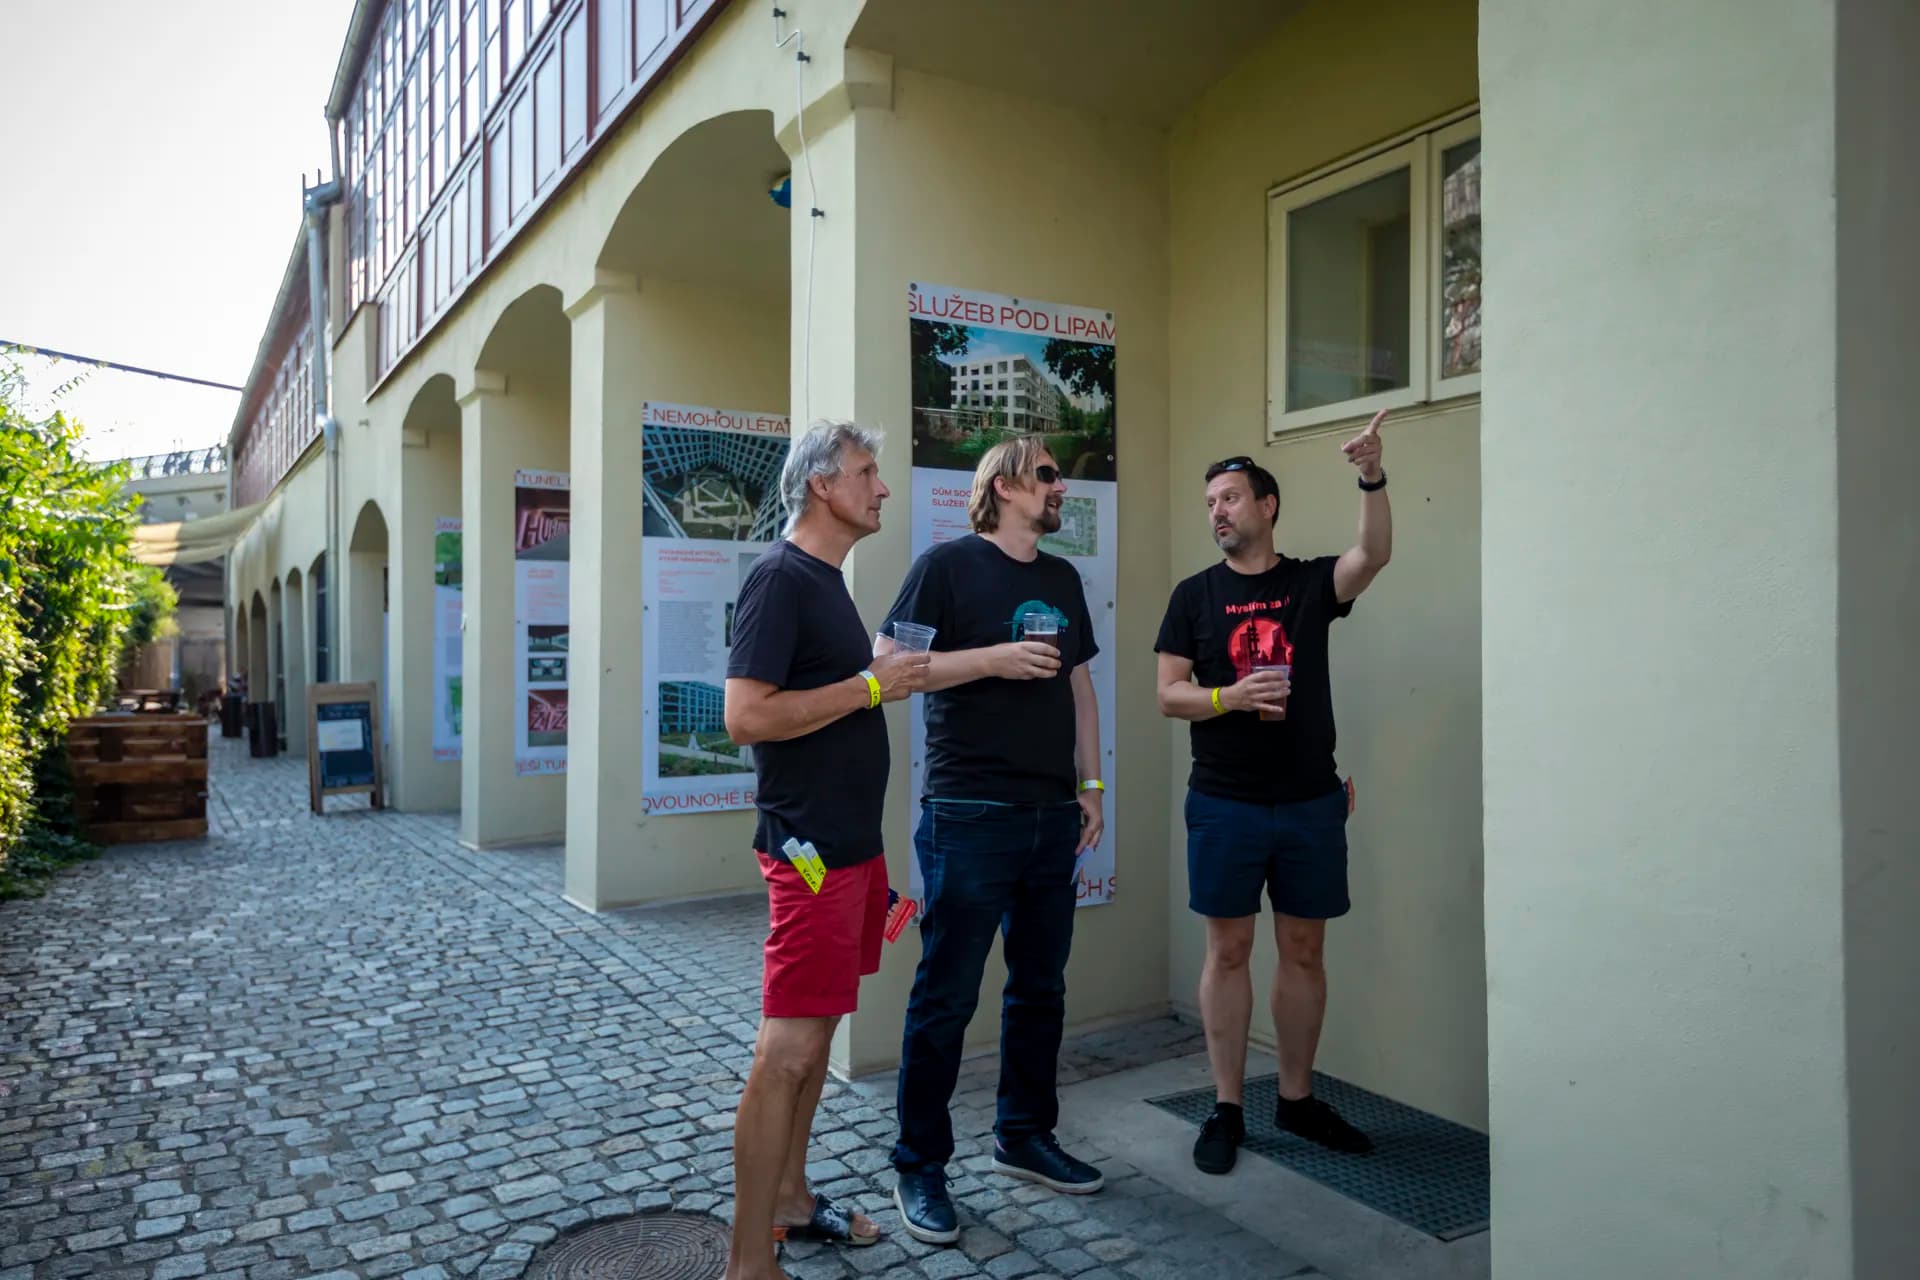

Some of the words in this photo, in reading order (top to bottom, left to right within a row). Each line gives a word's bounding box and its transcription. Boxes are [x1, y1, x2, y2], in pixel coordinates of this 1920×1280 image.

[908, 291, 994, 324] SLUŽEB
[1000, 306, 1049, 331] POD
[1054, 314, 1115, 340] LIPAM
[653, 408, 743, 430] NEMOHOU
